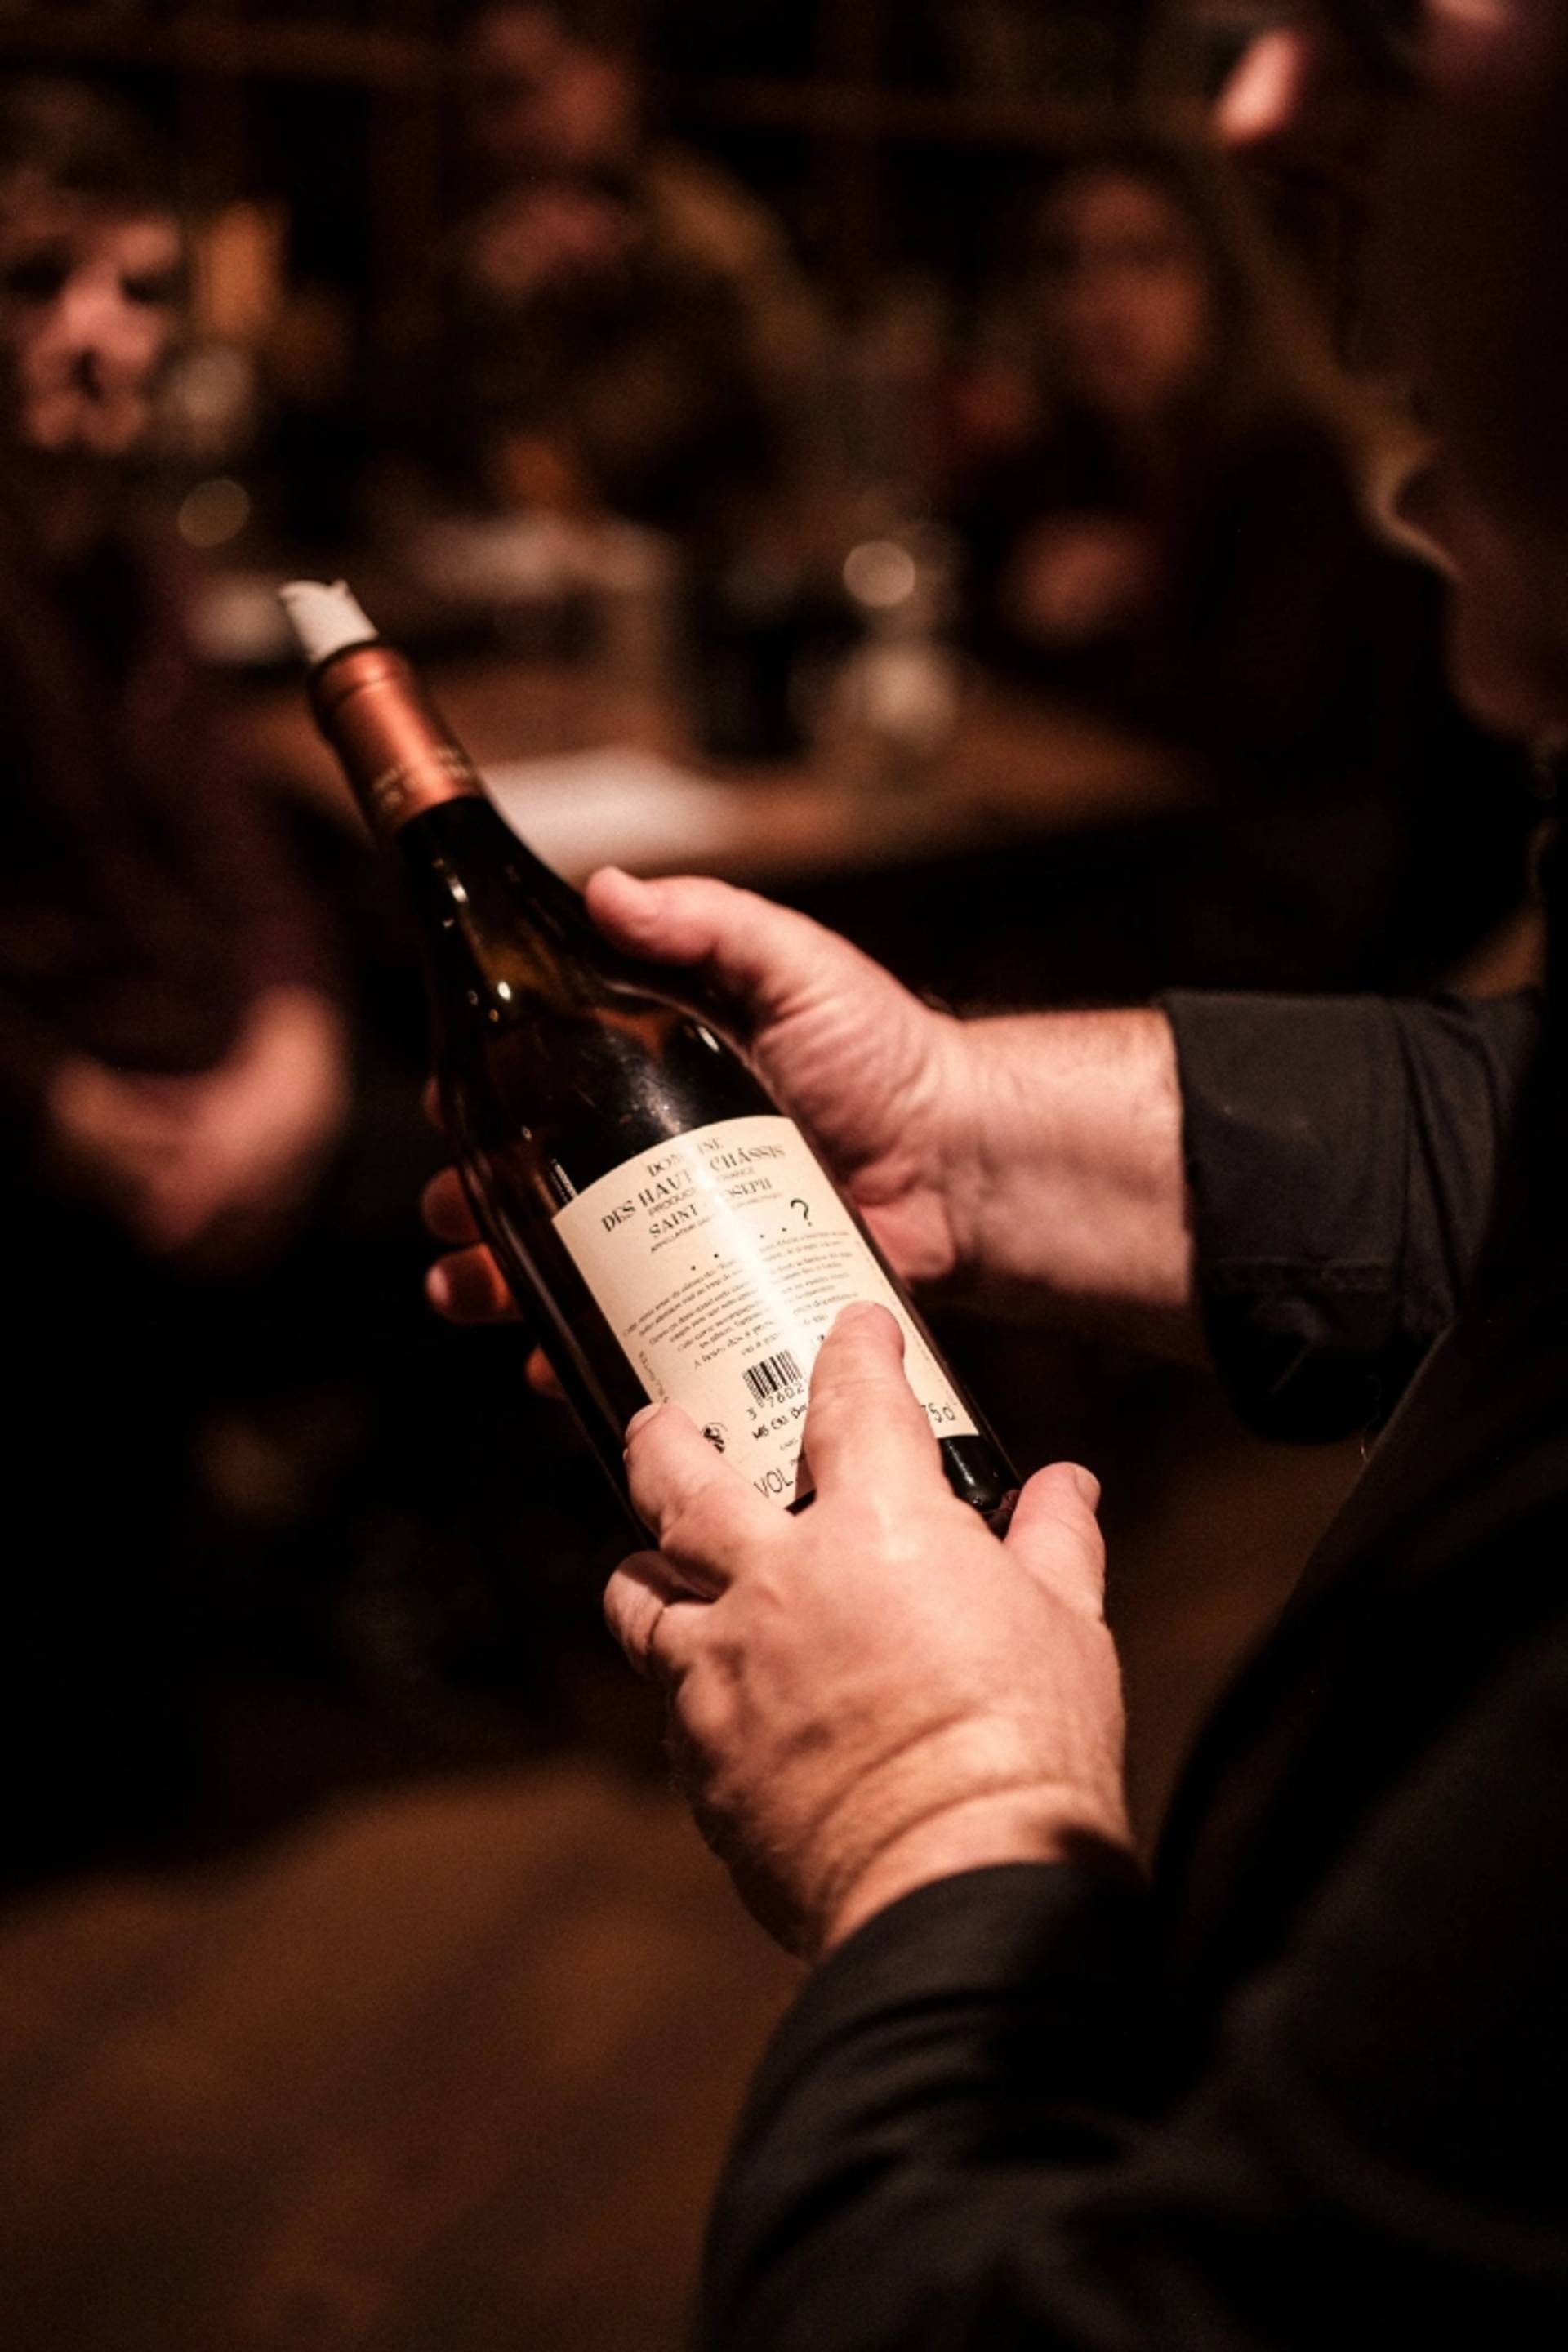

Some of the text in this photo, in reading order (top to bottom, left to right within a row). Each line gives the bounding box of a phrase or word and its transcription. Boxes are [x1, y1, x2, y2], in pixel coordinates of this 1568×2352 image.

[600, 1199, 636, 1232] DES
[648, 1202, 699, 1239] SAINT
[753, 1467, 795, 1499] VOL
